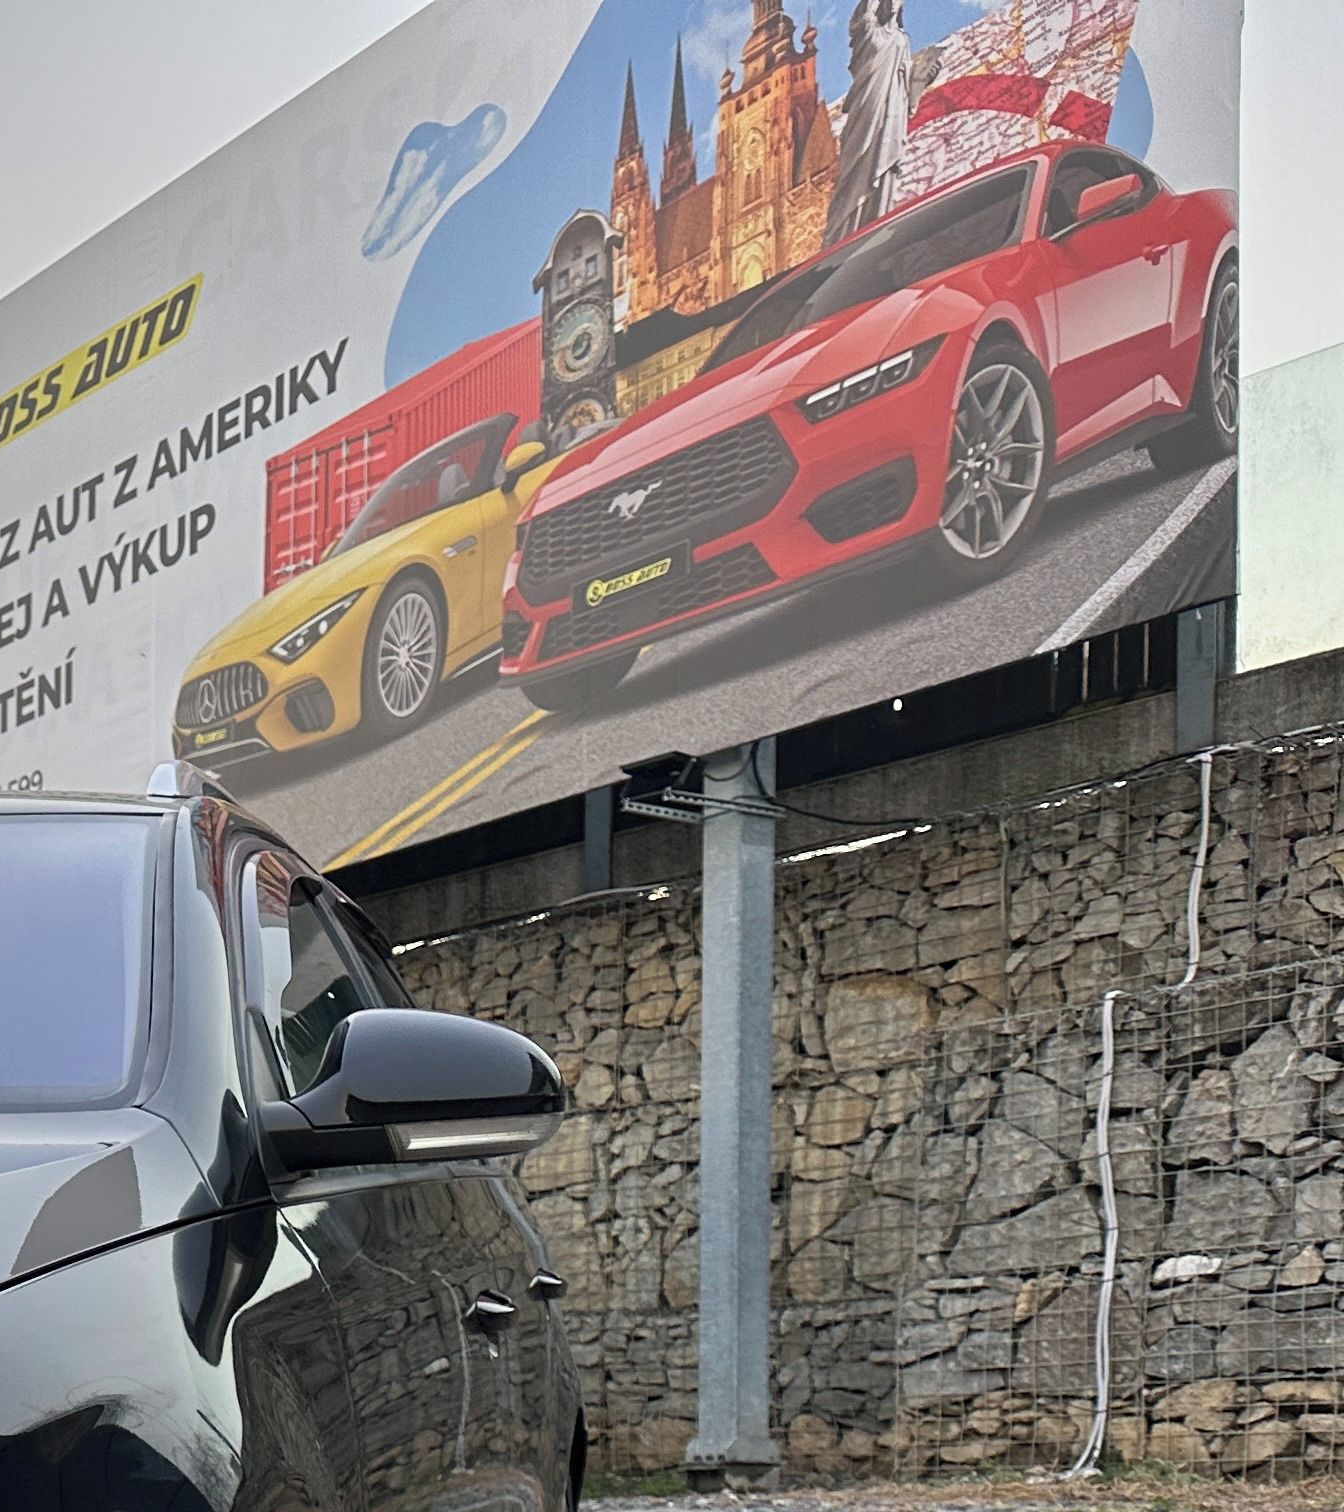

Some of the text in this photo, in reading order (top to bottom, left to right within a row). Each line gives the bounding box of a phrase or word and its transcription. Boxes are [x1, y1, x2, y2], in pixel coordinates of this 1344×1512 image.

[71, 282, 198, 400] AUTO
[28, 474, 103, 555] AUT
[113, 454, 138, 509] Z
[146, 338, 349, 491] AMERIKY
[41, 578, 69, 630] A
[79, 503, 216, 606] VÝKUP
